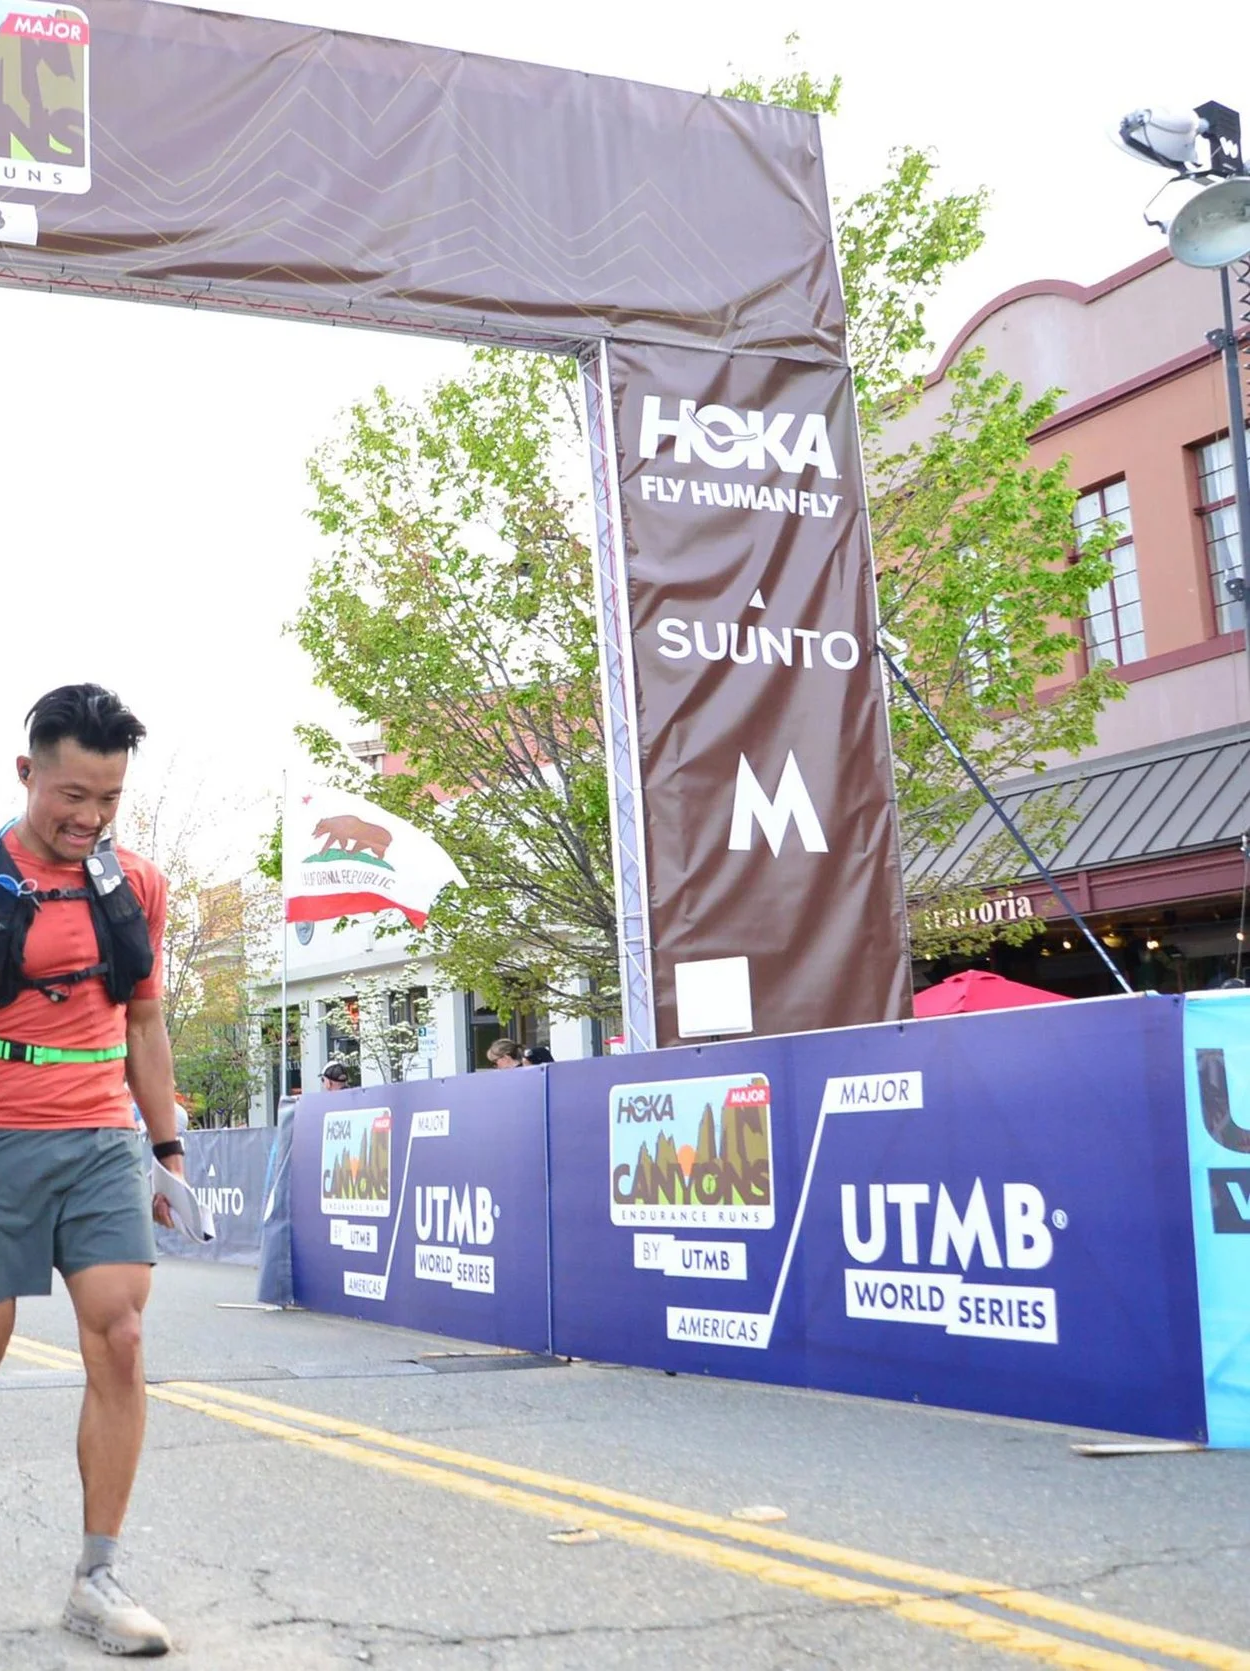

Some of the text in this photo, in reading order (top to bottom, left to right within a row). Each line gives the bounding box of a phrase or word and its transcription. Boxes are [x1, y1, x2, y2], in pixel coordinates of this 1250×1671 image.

[14, 16, 82, 41] MAJOR
[639, 395, 840, 480] HOKA
[640, 475, 840, 519] FLY HUMAN FLY
[656, 617, 860, 671] SUUNTO
[730, 1088, 767, 1104] MAJOR
[839, 1079, 910, 1106] MAJOR
[417, 1114, 445, 1132] MAJOR
[617, 1094, 675, 1124] HOKA
[323, 1163, 389, 1200] CANYONS
[613, 1154, 771, 1206] CANYONS
[621, 1209, 760, 1224] ENDURANCE RUNS
[350, 1230, 371, 1247] UTMB
[418, 1252, 491, 1285] WORLD SERIES
[642, 1241, 731, 1272] BY UTMB
[348, 1278, 383, 1297] AMERICAS
[854, 1281, 1047, 1331] WORLD SERIES
[676, 1314, 759, 1342] AMERICAS
